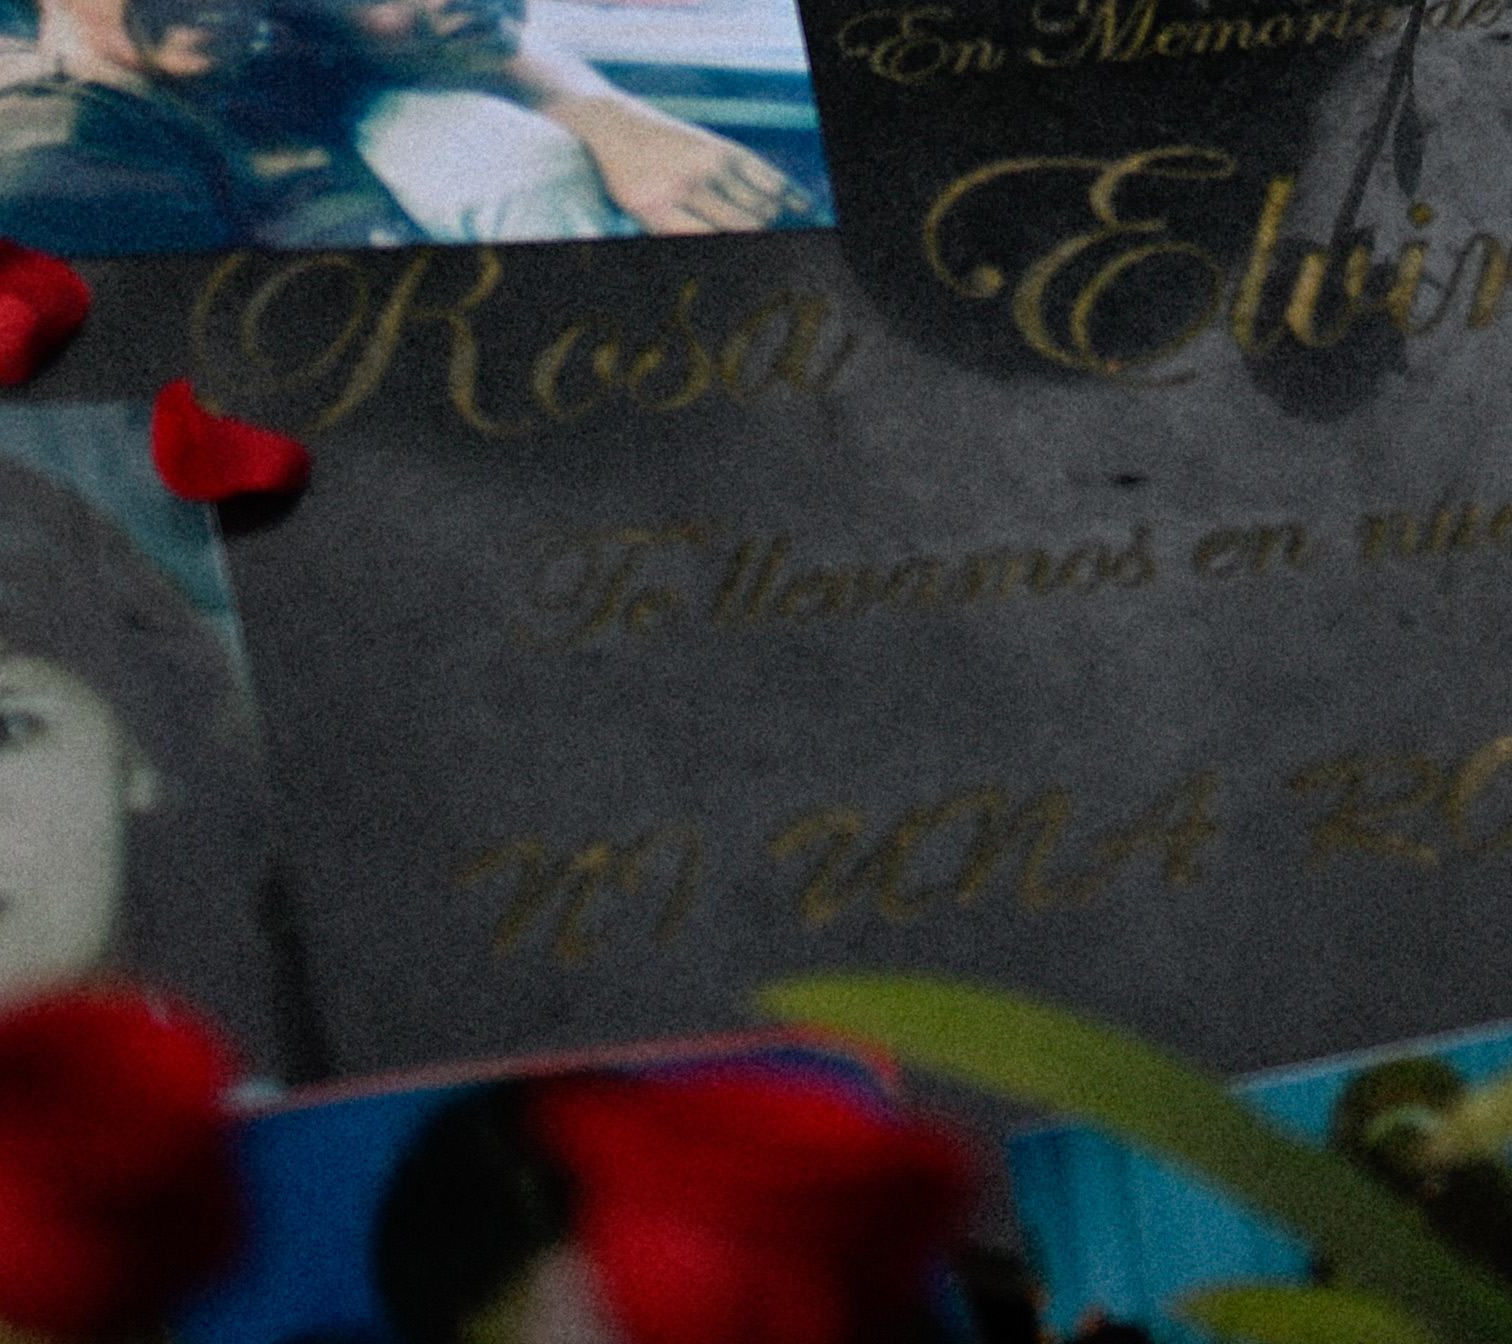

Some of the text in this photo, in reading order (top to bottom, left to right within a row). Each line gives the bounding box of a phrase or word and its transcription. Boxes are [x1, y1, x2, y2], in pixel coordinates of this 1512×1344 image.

[837, 4, 1005, 86] En
[189, 250, 867, 439] Rosa
[1190, 512, 1328, 582] en
